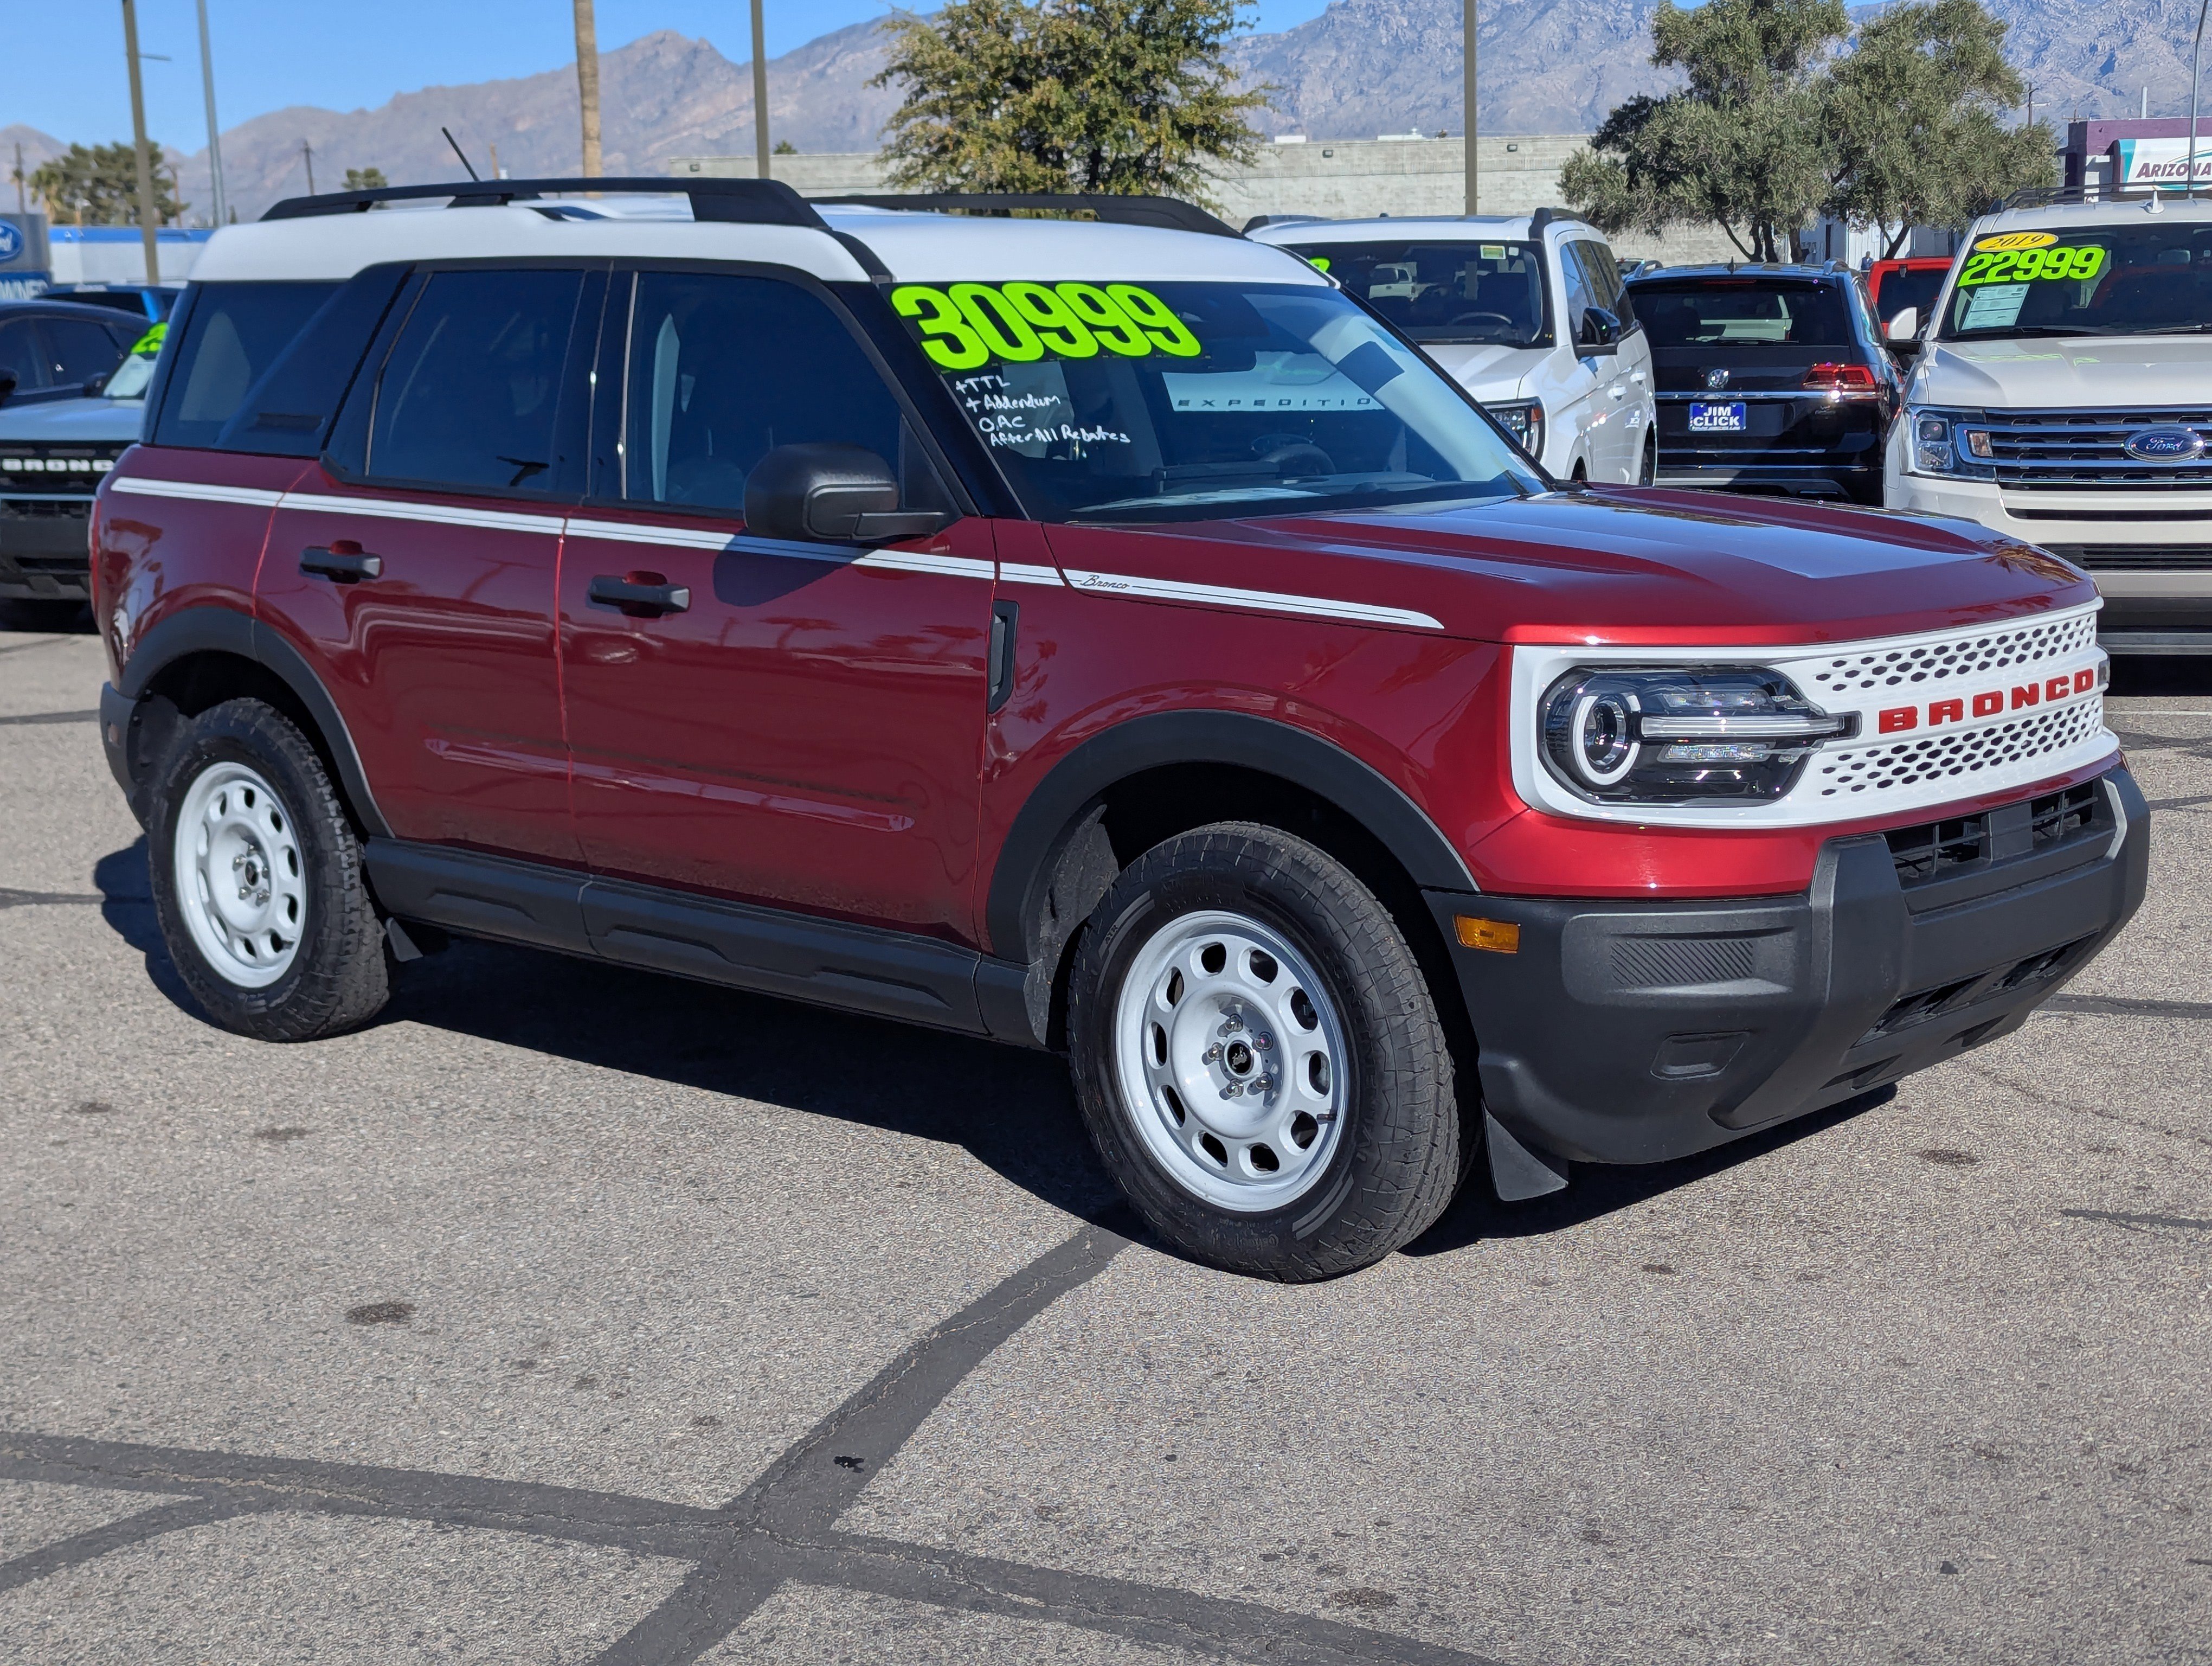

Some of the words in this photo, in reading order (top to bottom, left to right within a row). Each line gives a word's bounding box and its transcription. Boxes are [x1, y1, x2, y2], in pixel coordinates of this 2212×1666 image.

[1985, 234, 2044, 249] 2019
[1957, 247, 2106, 287] 22999
[891, 281, 1202, 370] 30999
[984, 393, 1060, 410] Addendum
[1703, 406, 1731, 416] JIM
[1693, 416, 1740, 426] CLICK
[1060, 424, 1130, 444] Rebates
[2146, 436, 2184, 451] Ford
[1080, 574, 1129, 589] Bronco
[1879, 669, 2093, 734] BRONCO
